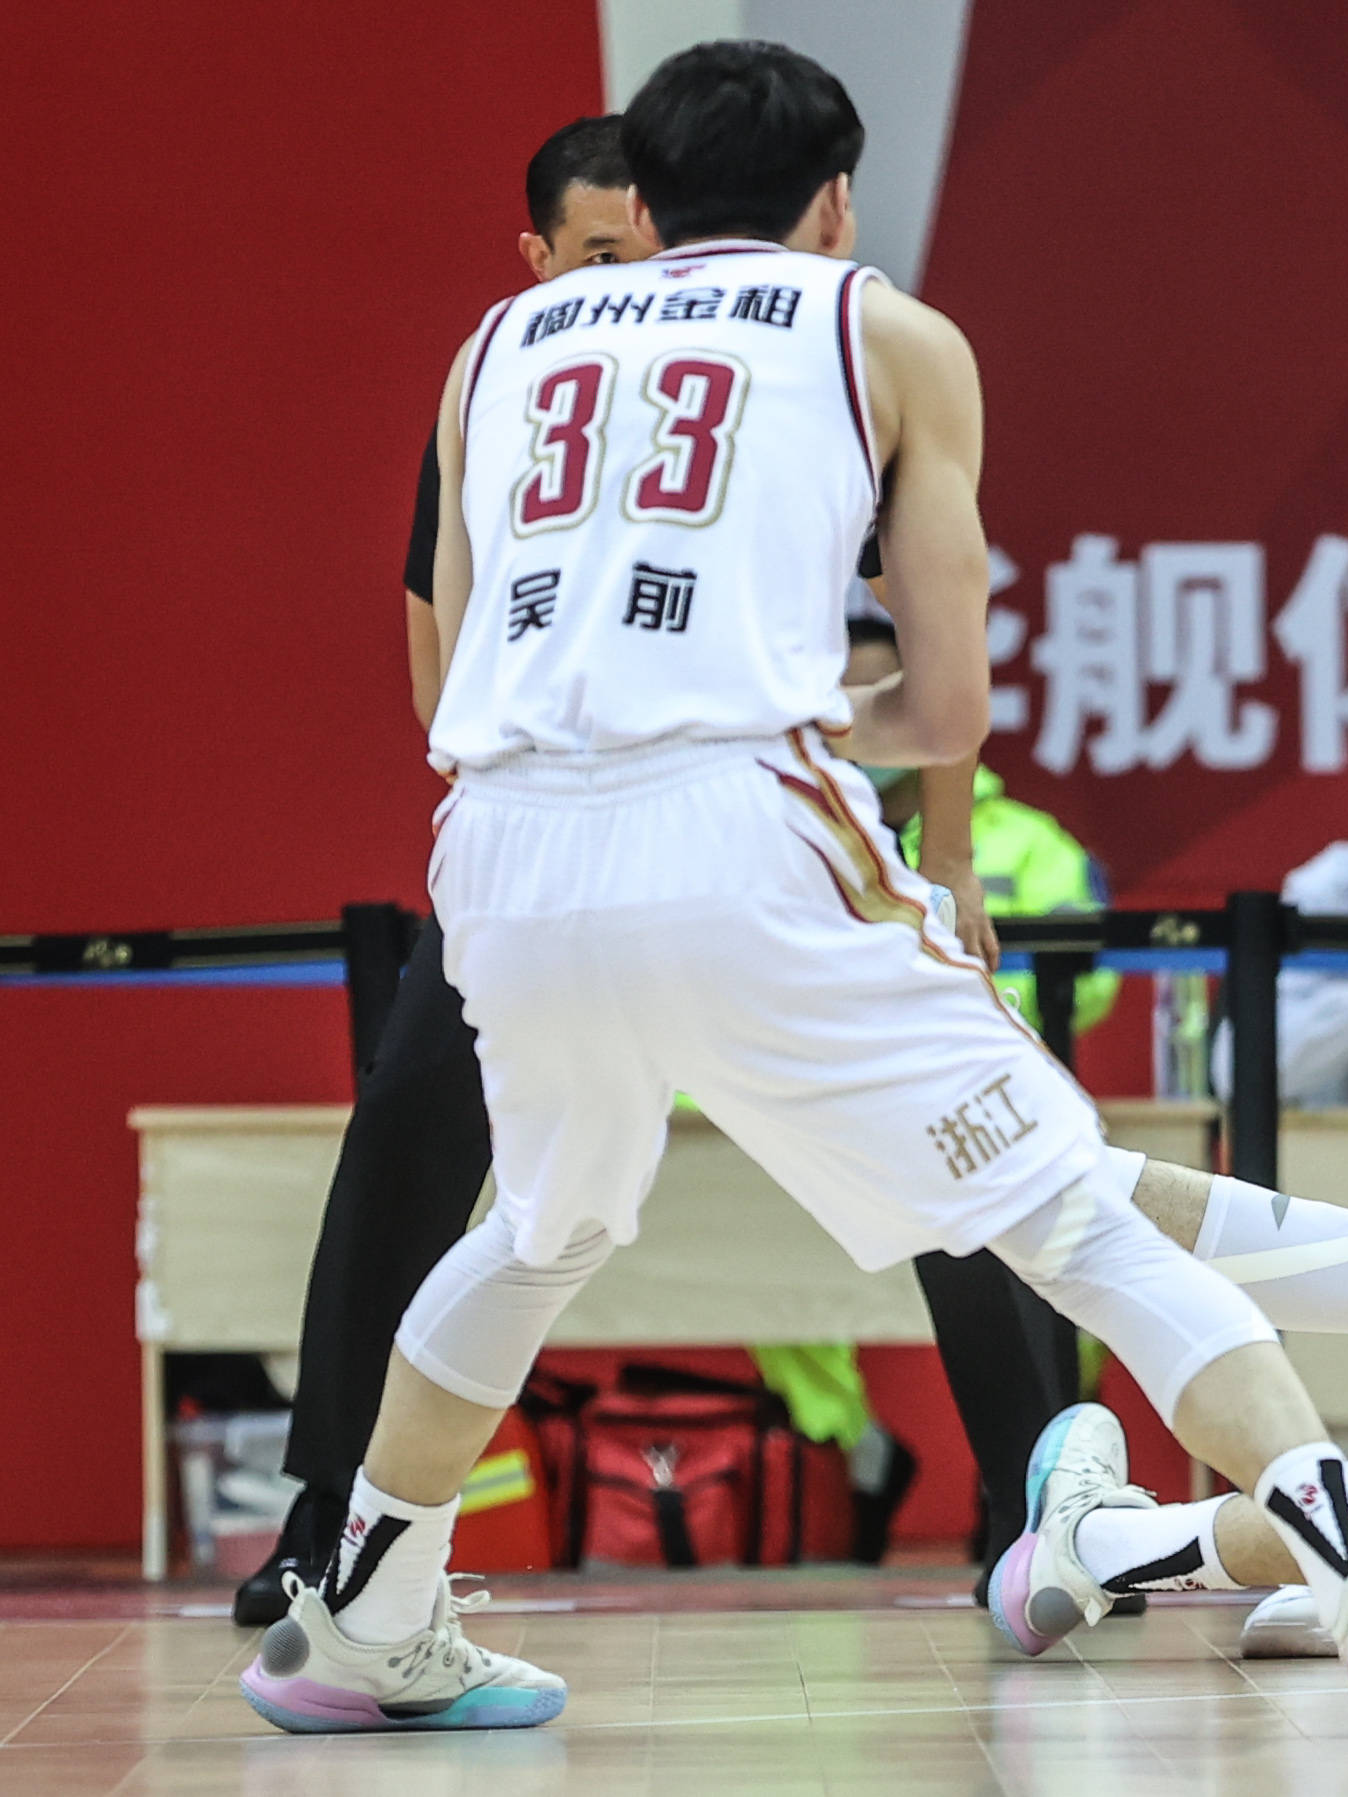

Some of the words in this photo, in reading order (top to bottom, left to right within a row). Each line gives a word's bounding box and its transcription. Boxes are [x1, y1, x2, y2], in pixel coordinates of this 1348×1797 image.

[509, 349, 751, 541] 33
[506, 560, 698, 644] 吴前
[925, 1072, 1039, 1181] 浙江
